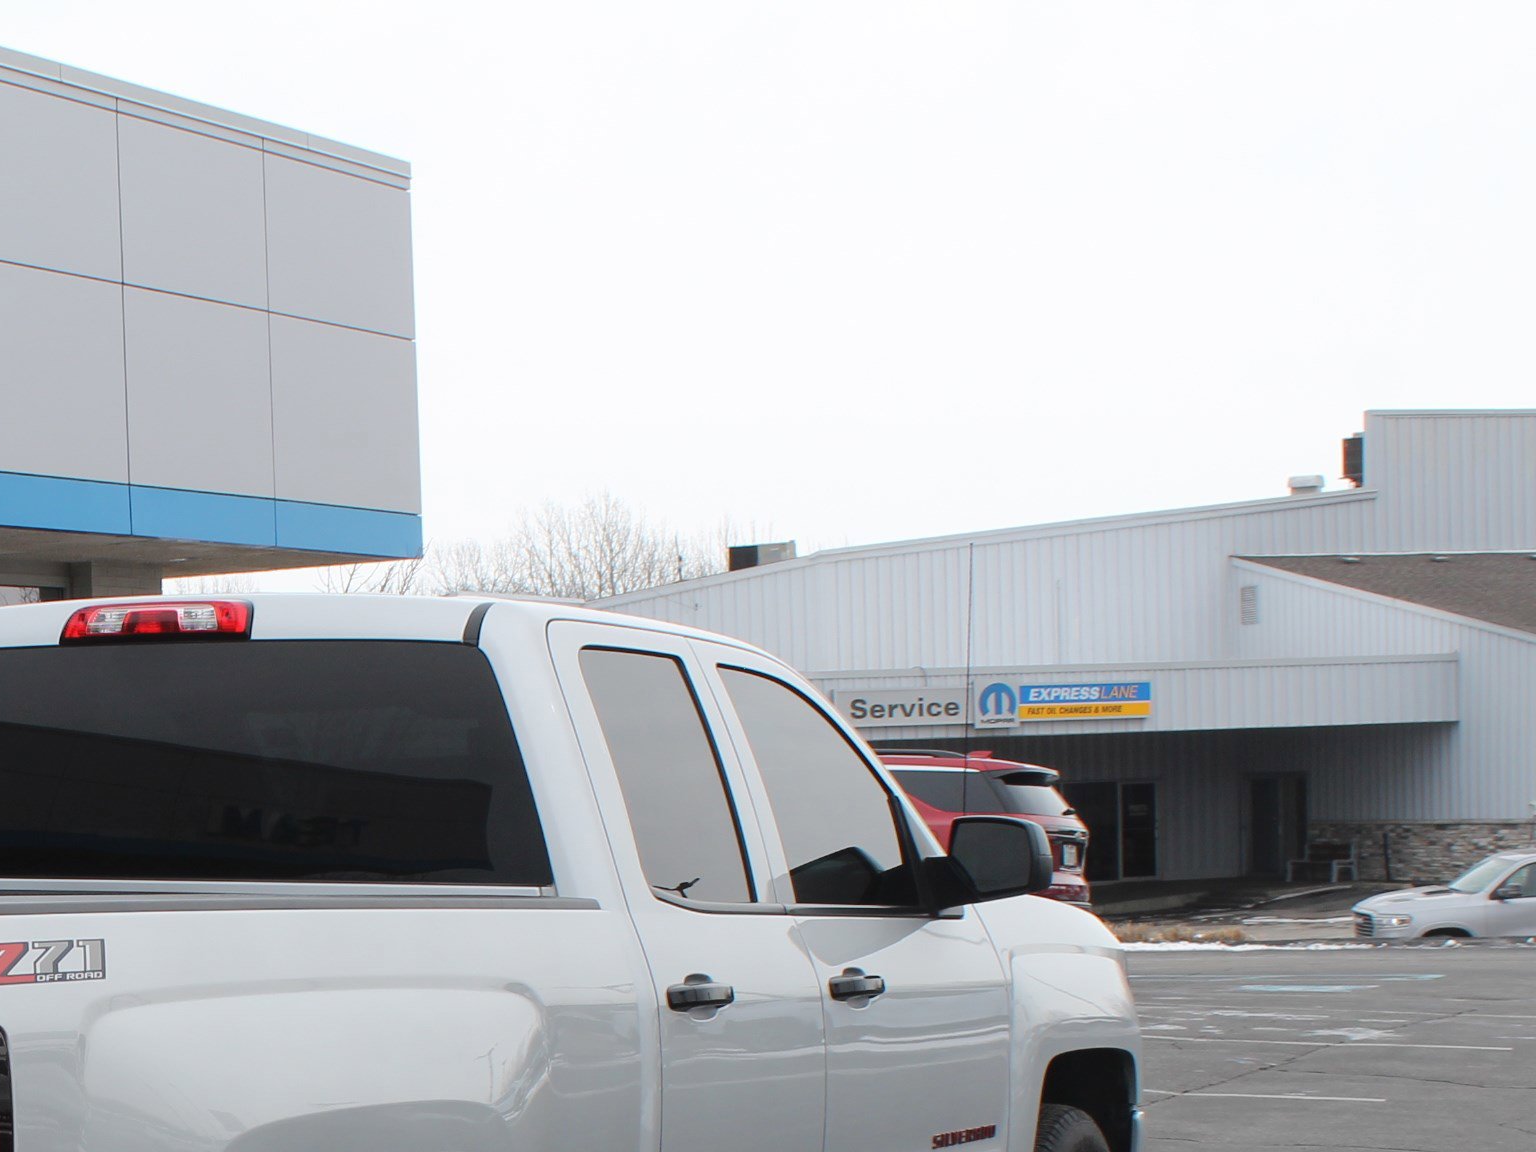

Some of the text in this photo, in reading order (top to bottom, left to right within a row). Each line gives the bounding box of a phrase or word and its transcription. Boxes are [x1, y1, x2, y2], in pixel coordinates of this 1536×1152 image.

[849, 697, 960, 720] Service
[1027, 707, 1045, 715] FAST
[1046, 707, 1057, 715] OIL
[1058, 706, 1093, 715] CHANGES
[1101, 705, 1123, 713] MORE
[36, 971, 104, 982] OFF ROAD
